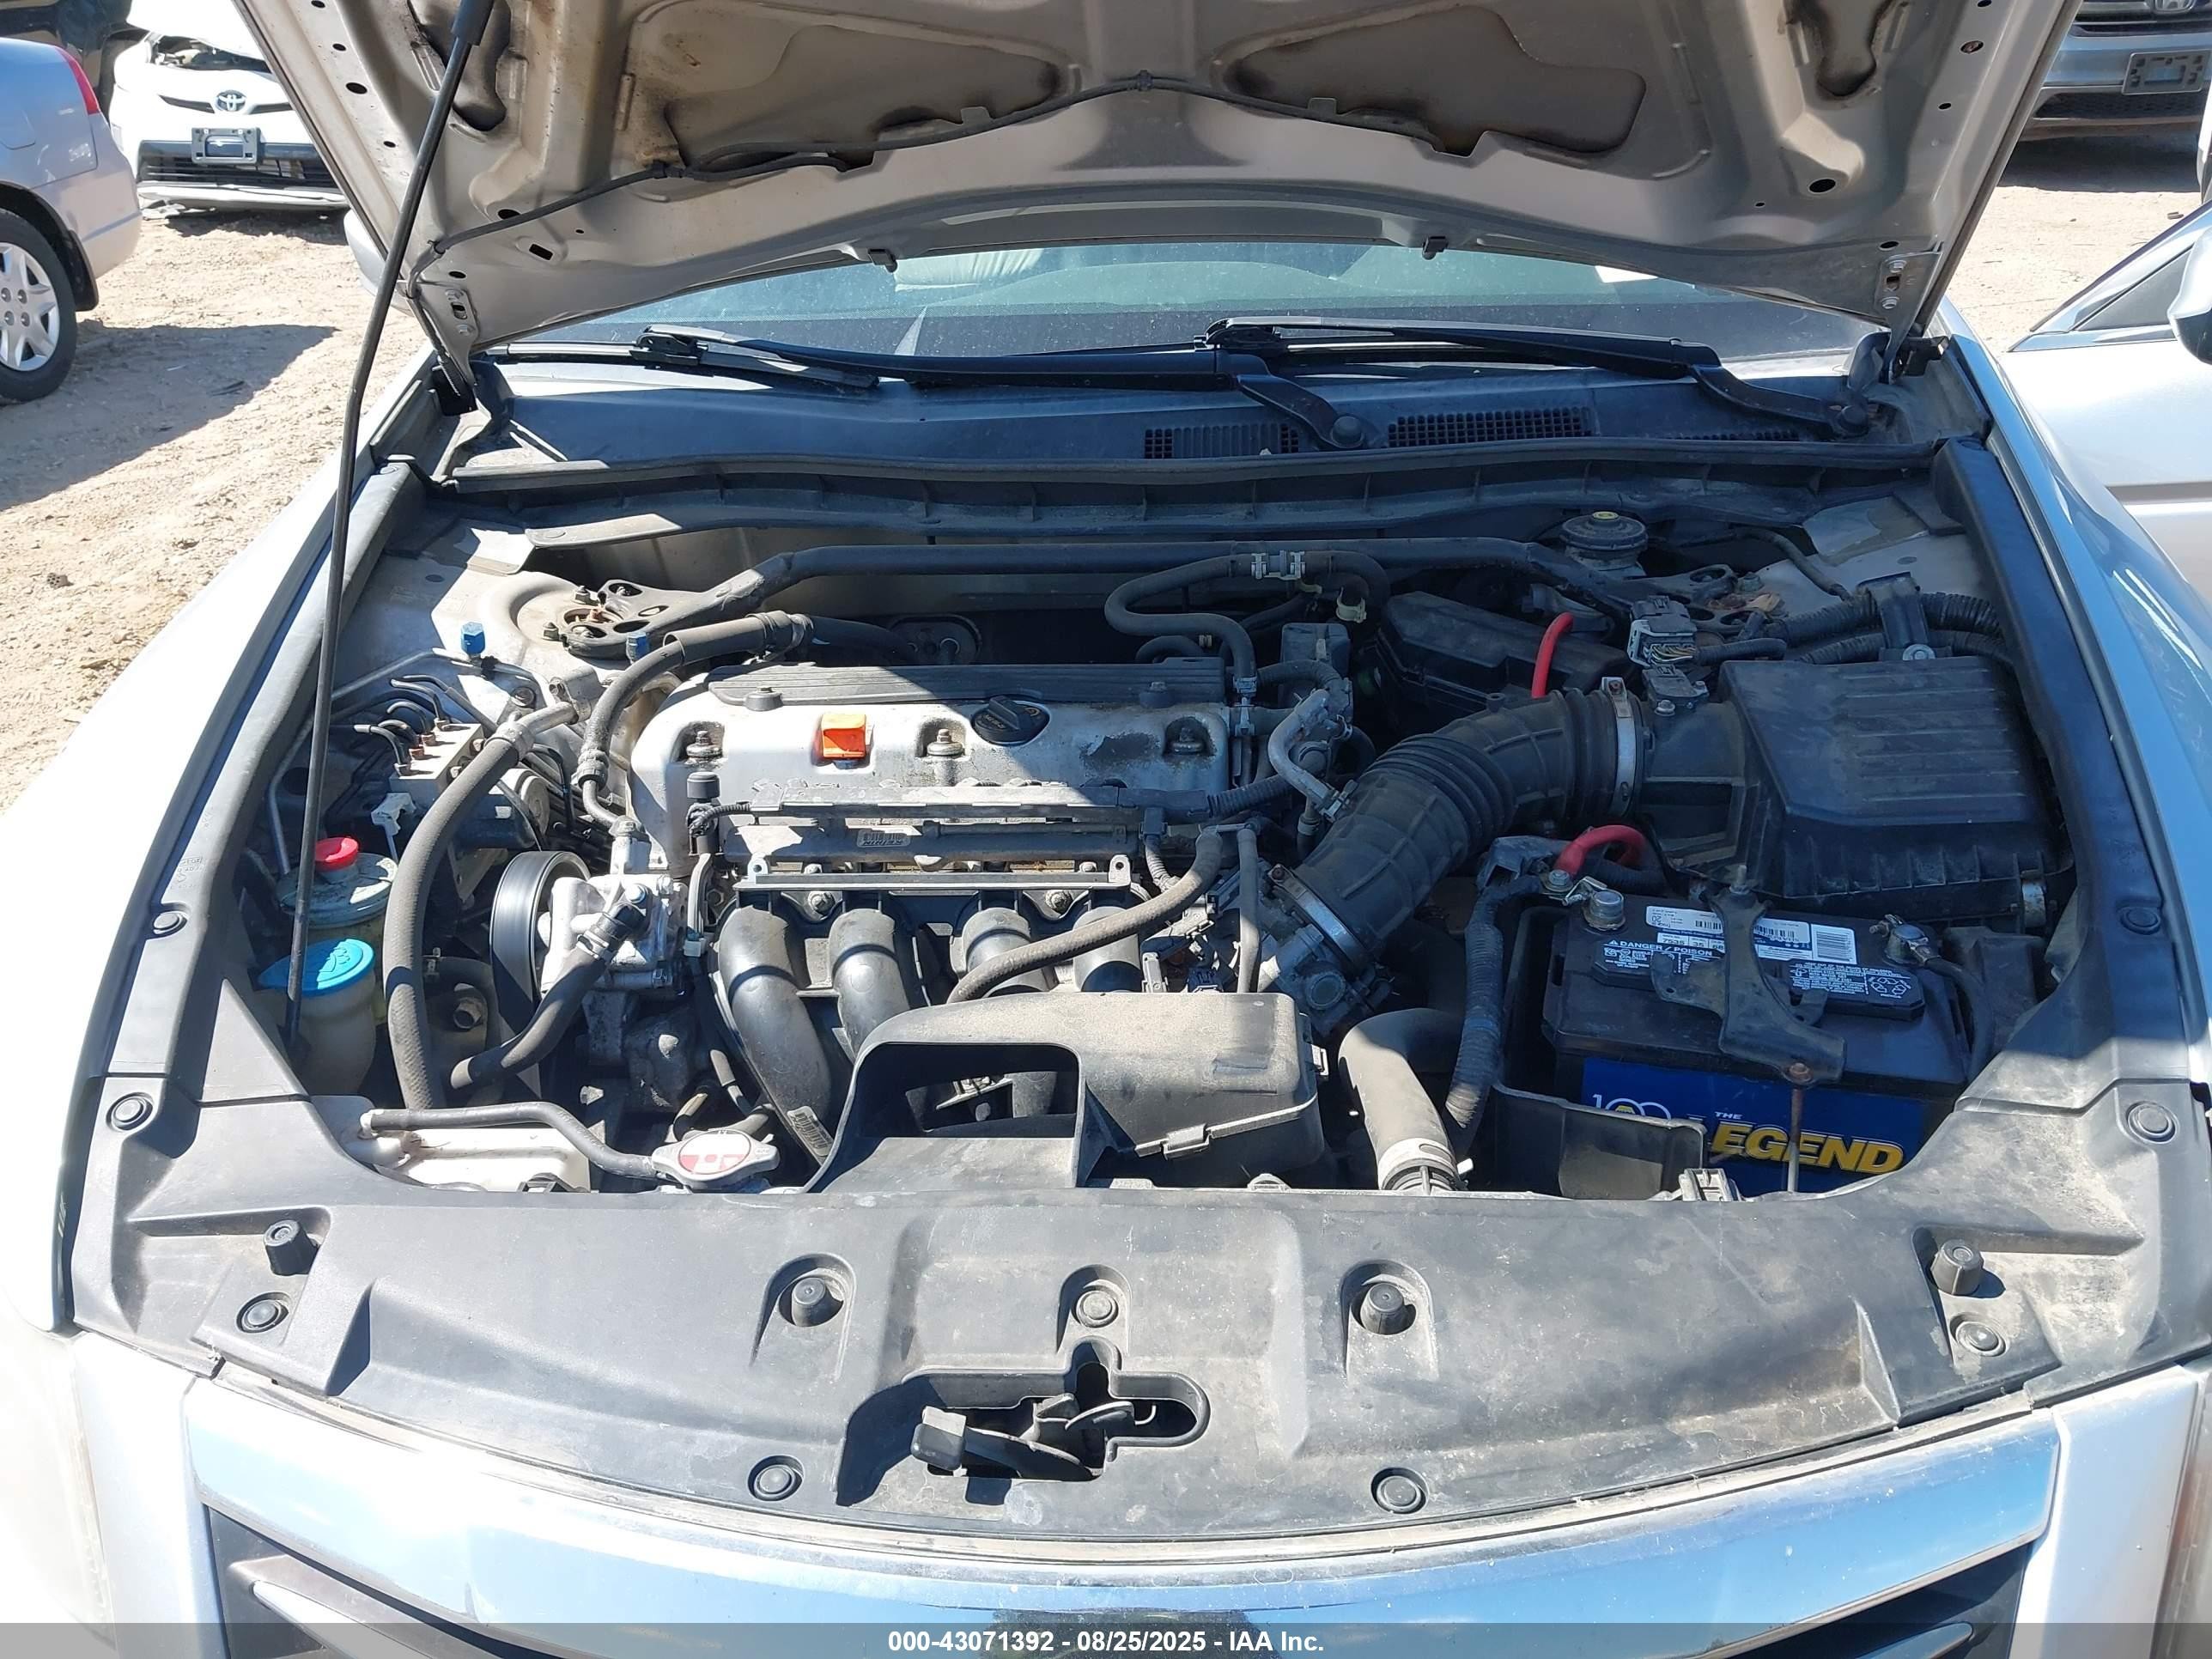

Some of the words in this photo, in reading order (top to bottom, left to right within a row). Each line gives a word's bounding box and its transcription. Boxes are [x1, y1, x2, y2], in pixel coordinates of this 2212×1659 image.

[1620, 940, 1663, 951] DANGER
[1674, 946, 1712, 957] POISON
[1715, 1111, 1743, 1120] THE
[1707, 1120, 1904, 1175] EGEND
